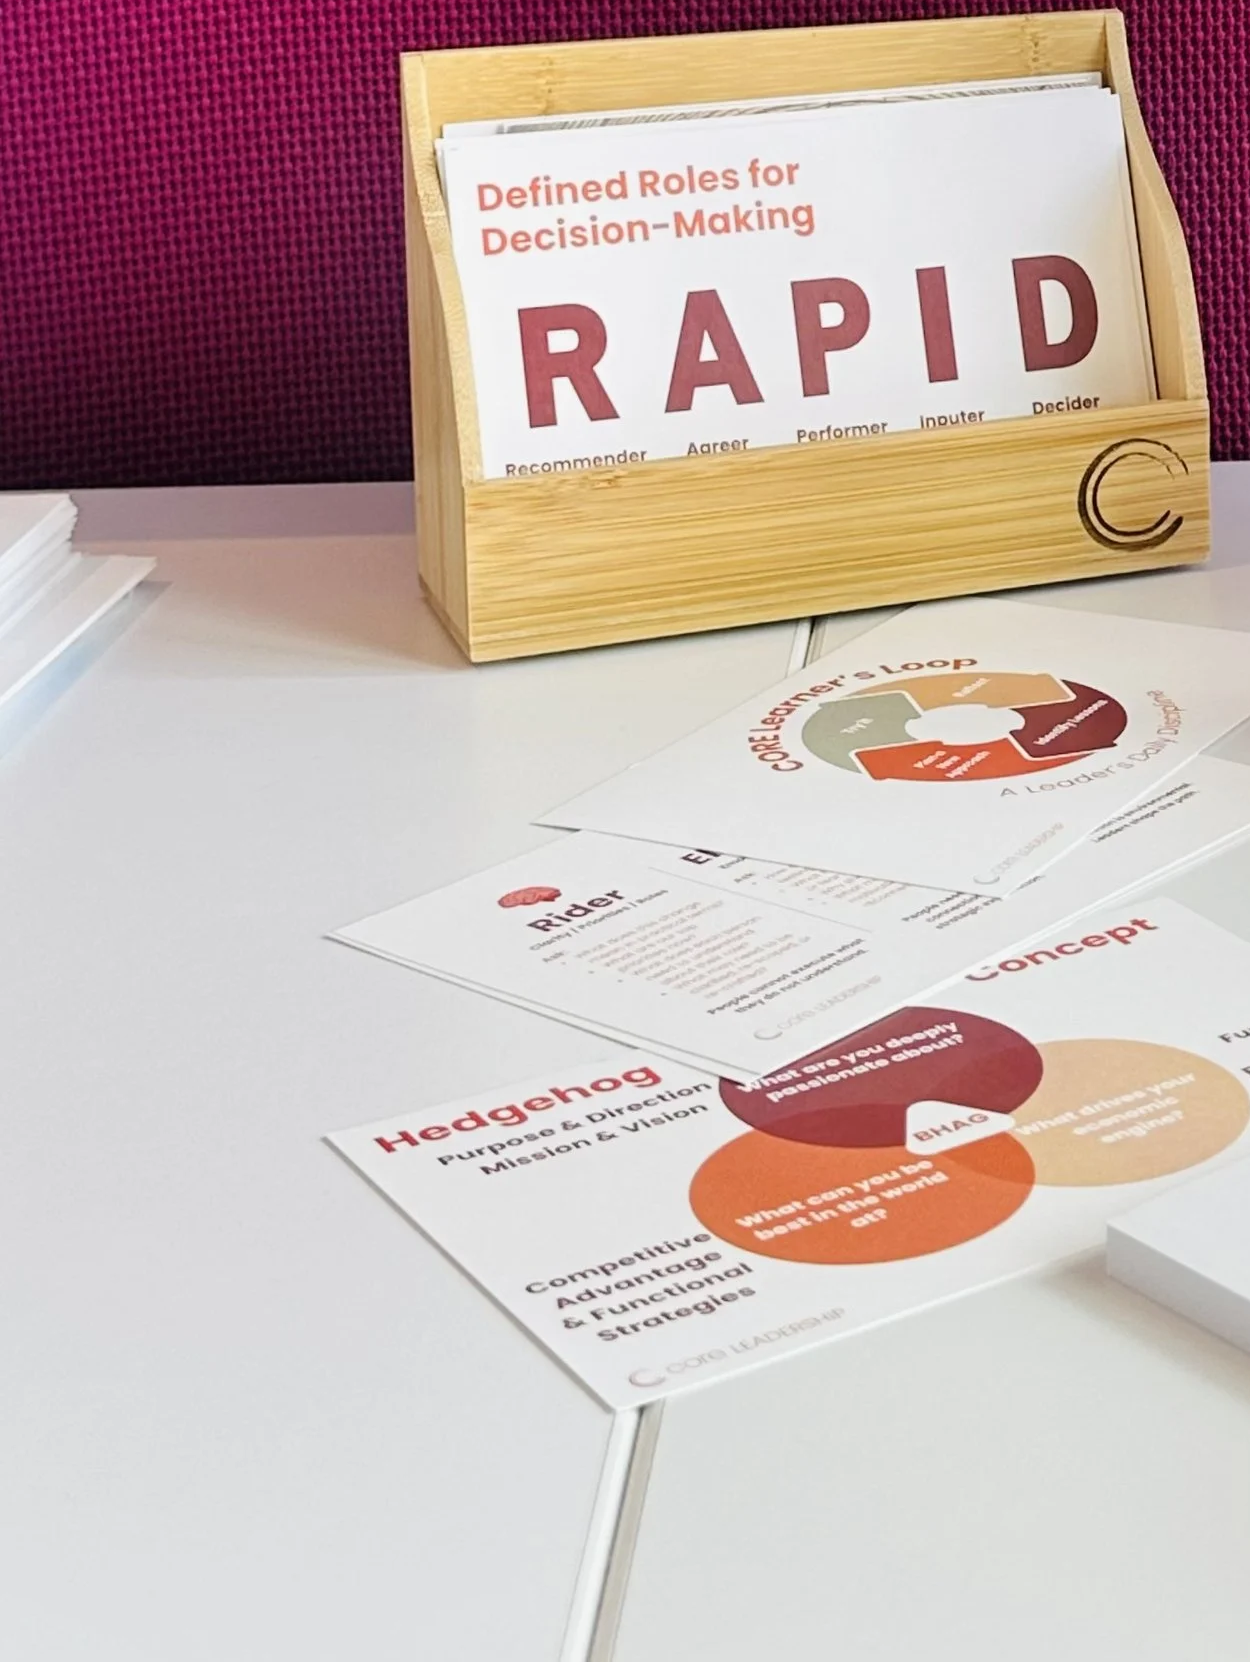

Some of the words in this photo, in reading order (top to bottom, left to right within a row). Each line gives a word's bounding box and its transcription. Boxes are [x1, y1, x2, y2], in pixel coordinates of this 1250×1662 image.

[477, 169, 630, 214] Defined
[638, 162, 741, 199] Roles
[748, 158, 802, 191] for
[480, 197, 817, 259] Decision-Making
[505, 449, 648, 477] Recommender
[795, 421, 889, 444] Performer
[1031, 395, 1101, 417] Decider
[879, 657, 978, 675] Loop
[749, 670, 877, 734] Learner's
[1146, 689, 1188, 737] Discipline
[748, 734, 805, 774] CORE
[1026, 761, 1134, 795] Leader's
[1127, 737, 1180, 763] Daily
[1000, 786, 1018, 798] A
[526, 888, 627, 932] Rider
[735, 1067, 803, 1094] What
[800, 1056, 842, 1076] are
[840, 1043, 885, 1066] you
[885, 1020, 960, 1051] deeply
[765, 1058, 891, 1104] passionate
[890, 1032, 965, 1063] about?
[373, 1065, 663, 1155] Hedgehog
[436, 1127, 557, 1167] Purpose
[560, 1118, 585, 1131] &
[584, 1081, 713, 1125] Direction
[911, 1112, 991, 1143] BHAG
[1013, 1109, 1080, 1137] What
[1077, 1089, 1147, 1120] drives
[1145, 1071, 1197, 1098] your
[1072, 1095, 1181, 1138] economic
[1099, 1109, 1186, 1146] engine?
[478, 1136, 593, 1176] Mission
[595, 1129, 620, 1143] &
[620, 1102, 709, 1133] Vision
[734, 1200, 807, 1229] What
[806, 1185, 855, 1207] can
[852, 1169, 903, 1195] you
[901, 1158, 935, 1177] be
[752, 1216, 813, 1242] best
[811, 1207, 840, 1224] in
[837, 1193, 881, 1215] the
[879, 1170, 951, 1201] world
[849, 1207, 890, 1230] at?
[524, 1232, 713, 1295] Competitive
[555, 1250, 724, 1311] Advantage
[561, 1315, 588, 1331] &
[588, 1261, 755, 1321] Functional
[595, 1285, 757, 1343] Strategies
[664, 1349, 729, 1376] core
[732, 1306, 846, 1355] LEADERSHIP
